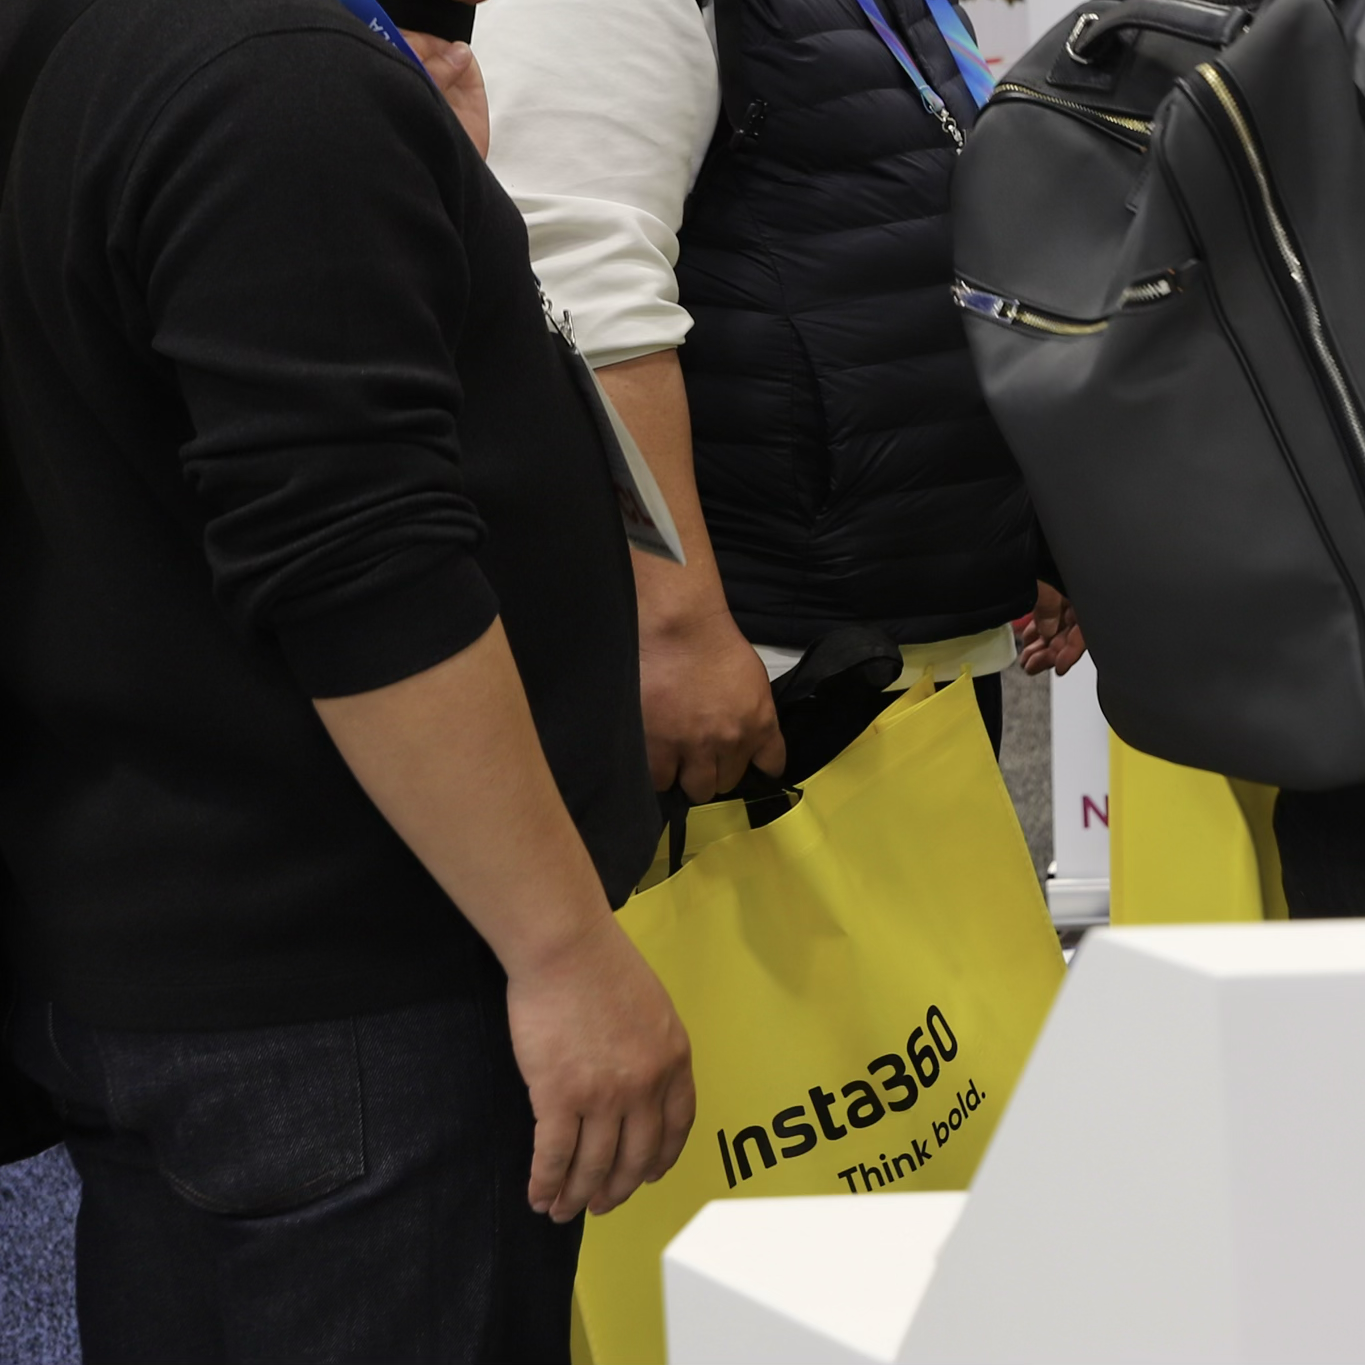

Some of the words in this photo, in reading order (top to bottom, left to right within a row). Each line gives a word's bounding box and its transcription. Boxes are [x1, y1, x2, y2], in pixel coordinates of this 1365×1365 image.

[717, 1004, 958, 1190] Insta360
[838, 1137, 933, 1195] Think
[931, 1079, 986, 1149] bold.
